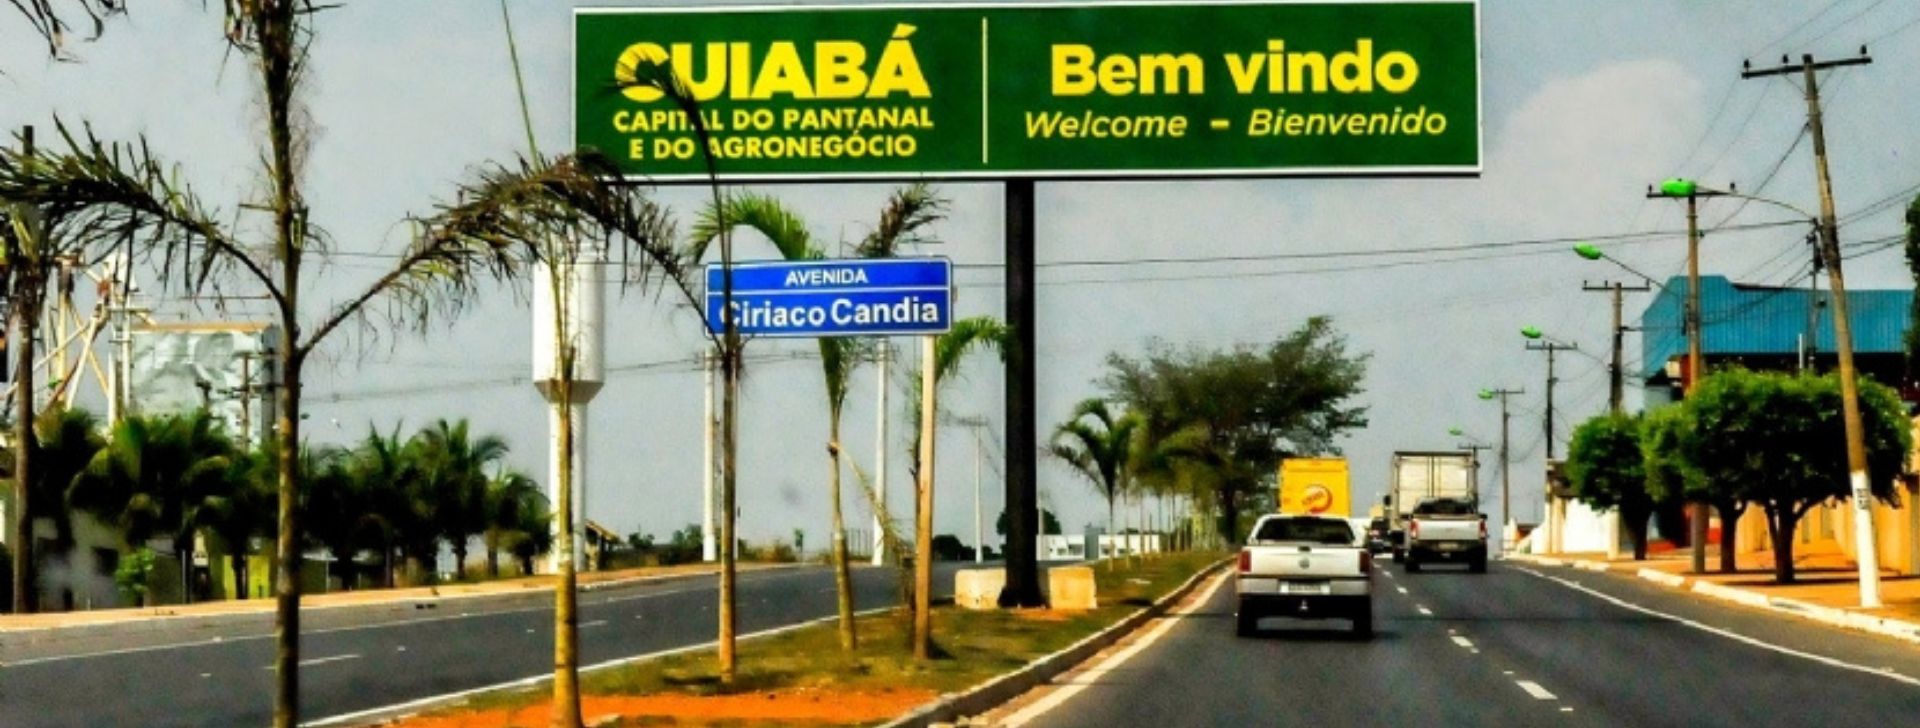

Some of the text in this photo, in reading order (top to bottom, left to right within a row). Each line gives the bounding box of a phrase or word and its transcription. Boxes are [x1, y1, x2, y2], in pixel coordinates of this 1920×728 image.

[614, 23, 932, 102] CUIABÁ
[1052, 39, 1419, 95] Bem vindo
[733, 108, 774, 130] DO
[783, 107, 934, 130] PANTANAL
[1026, 110, 1188, 138] Welcome
[1248, 106, 1447, 136] Bienvenido
[630, 131, 917, 159] E DO AGRONEGÓCIO
[785, 269, 868, 286] AVENIDA
[720, 296, 939, 327] Ciriaco Candia
